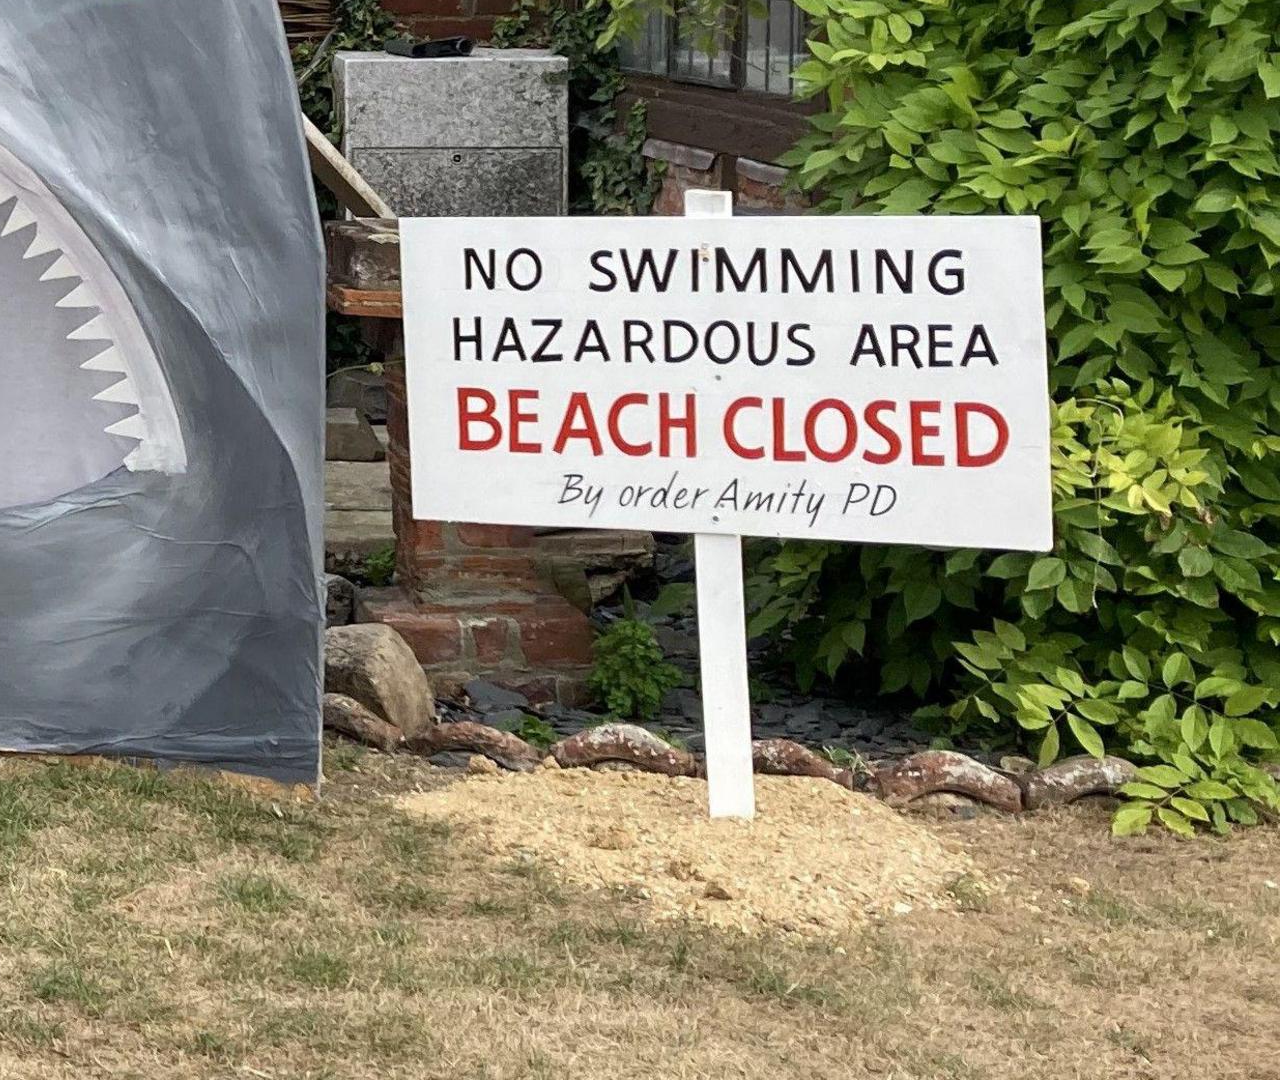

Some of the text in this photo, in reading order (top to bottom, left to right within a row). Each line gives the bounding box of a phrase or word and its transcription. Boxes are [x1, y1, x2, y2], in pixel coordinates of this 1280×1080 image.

[463, 247, 966, 296] NO SWIMMING
[453, 316, 1000, 368] HAZARDOUS AREA
[456, 387, 1009, 468] BEACH CLOSED
[557, 471, 897, 528] By order Amity PD
